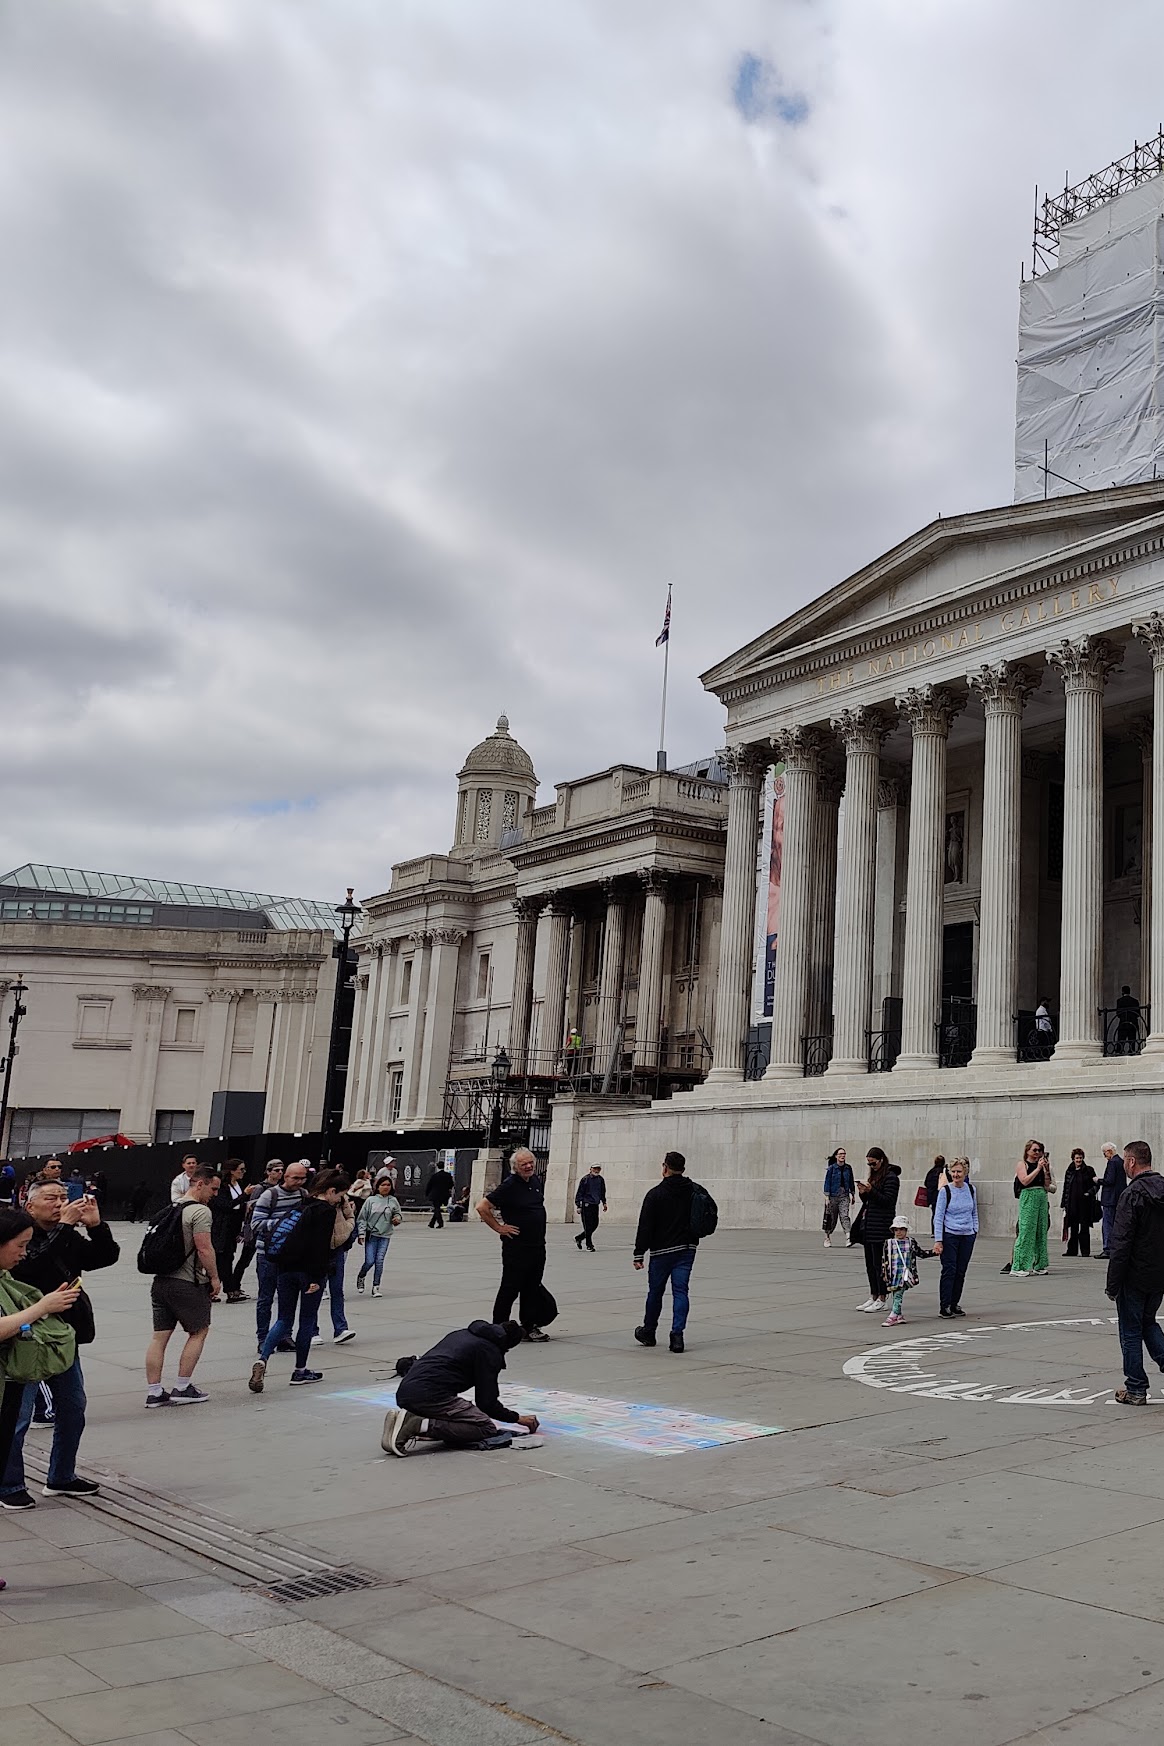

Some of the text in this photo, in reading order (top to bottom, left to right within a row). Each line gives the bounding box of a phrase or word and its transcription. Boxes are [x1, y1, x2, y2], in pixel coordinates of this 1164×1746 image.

[816, 575, 1122, 695] THE NATIONAL GALLERY
